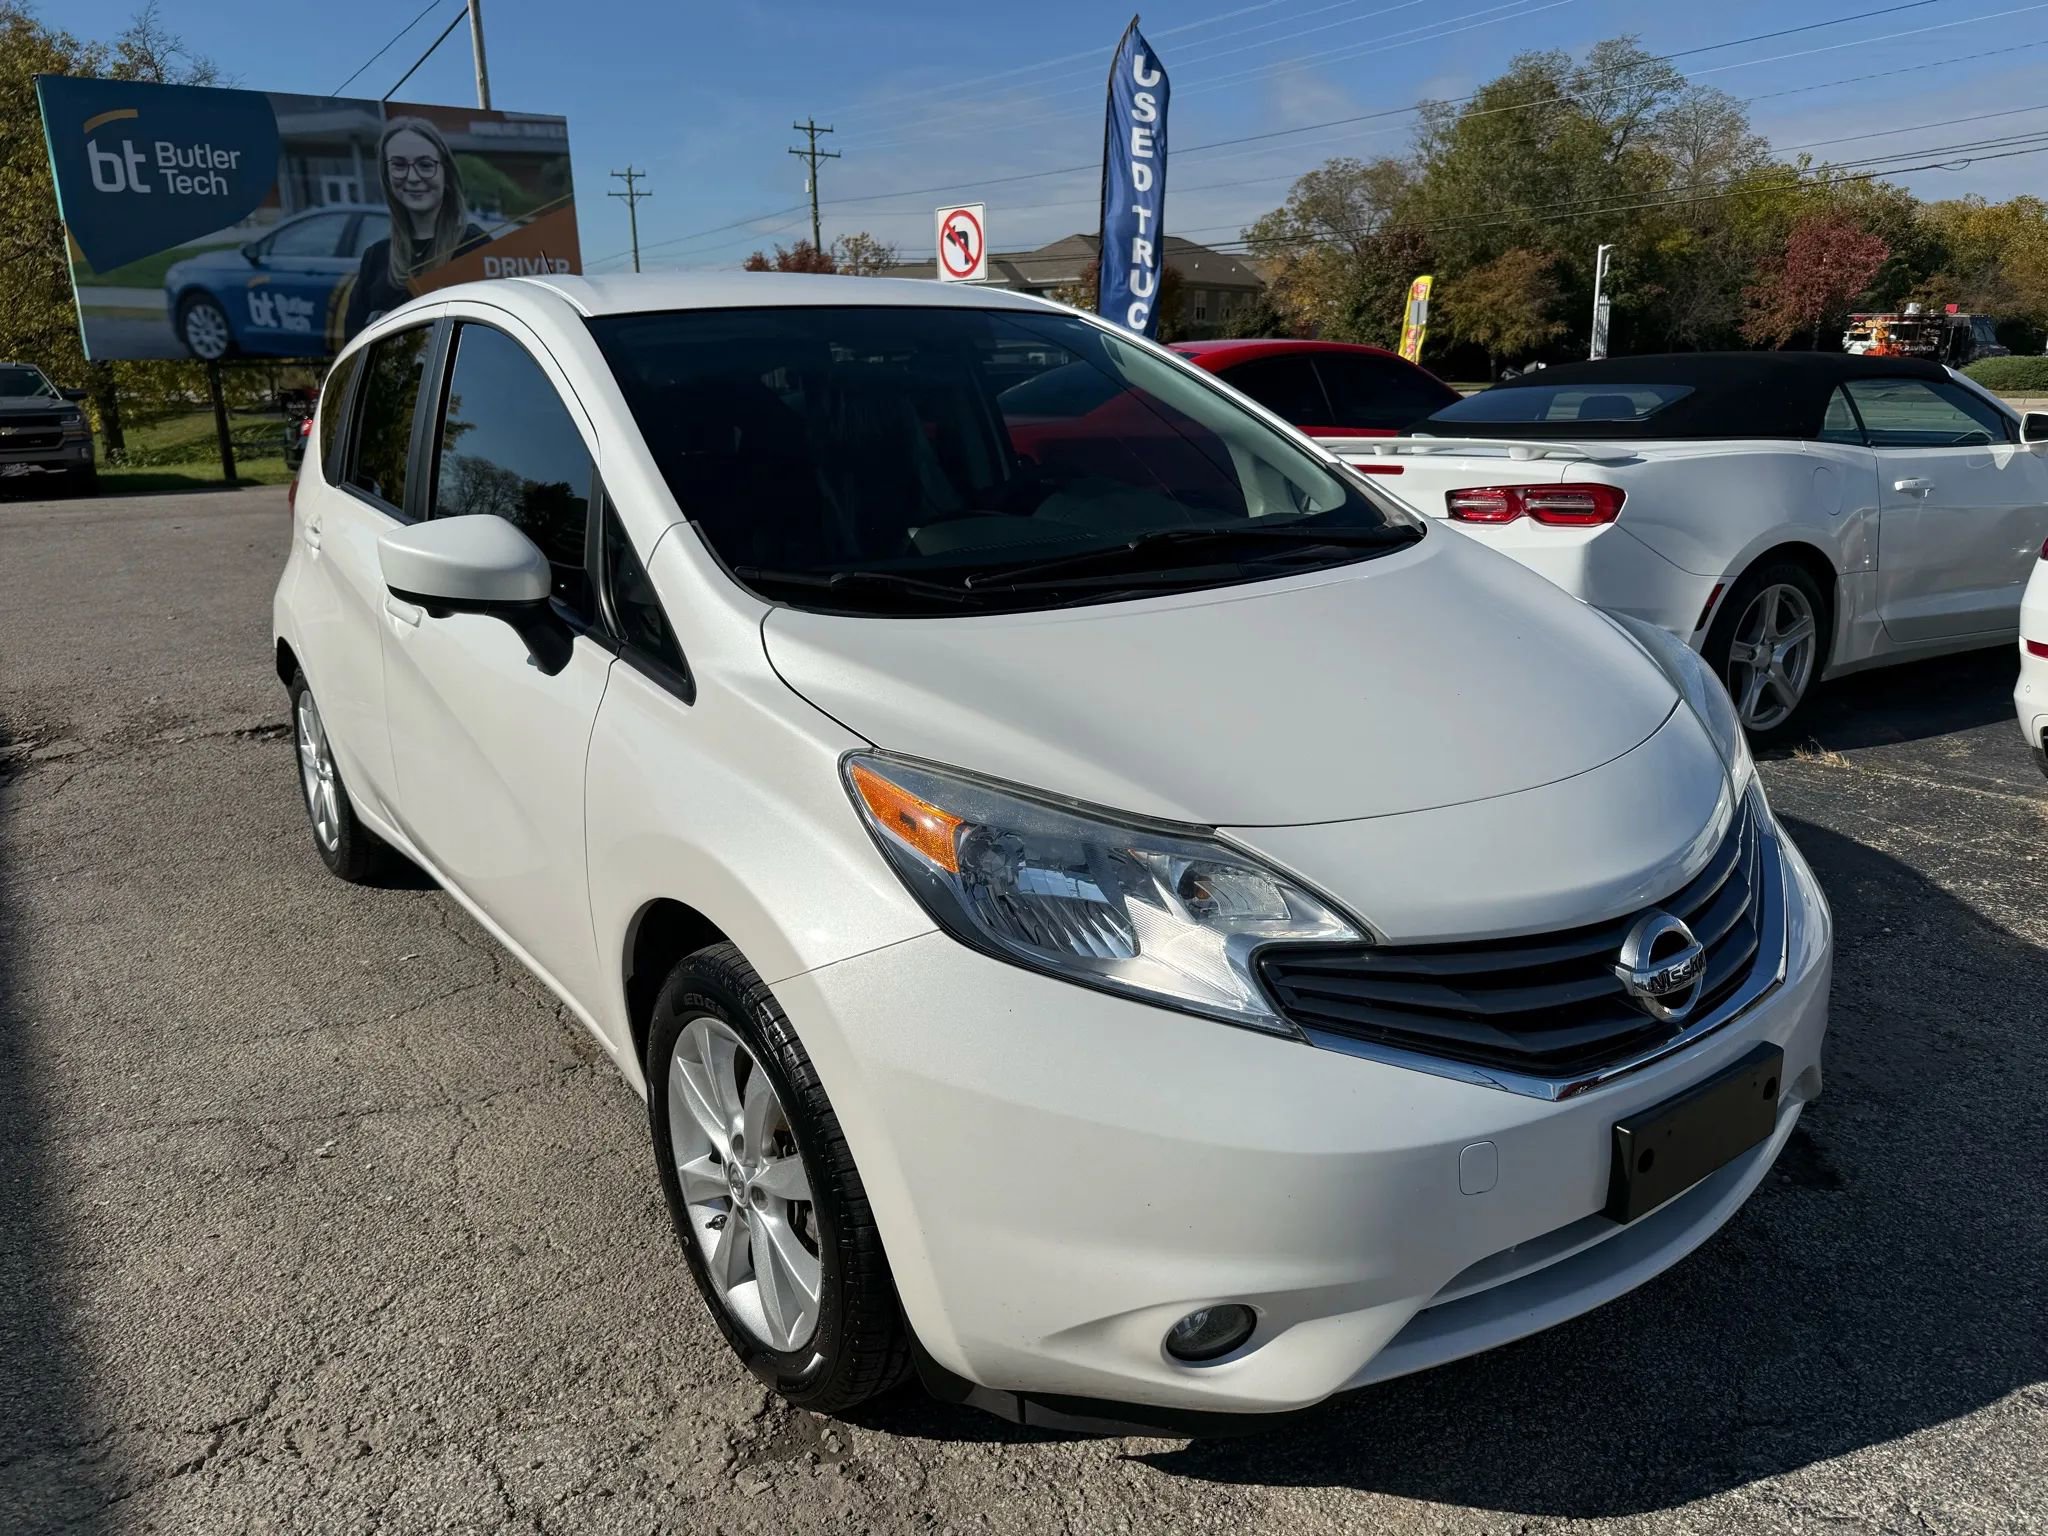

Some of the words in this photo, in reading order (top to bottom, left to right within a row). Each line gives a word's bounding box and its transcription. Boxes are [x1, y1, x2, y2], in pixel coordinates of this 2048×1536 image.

[1131, 54, 1161, 192] USED
[86, 138, 151, 193] bt
[154, 141, 241, 169] Butler
[159, 168, 229, 195] Tech
[1650, 953, 1705, 993] NISSAN
